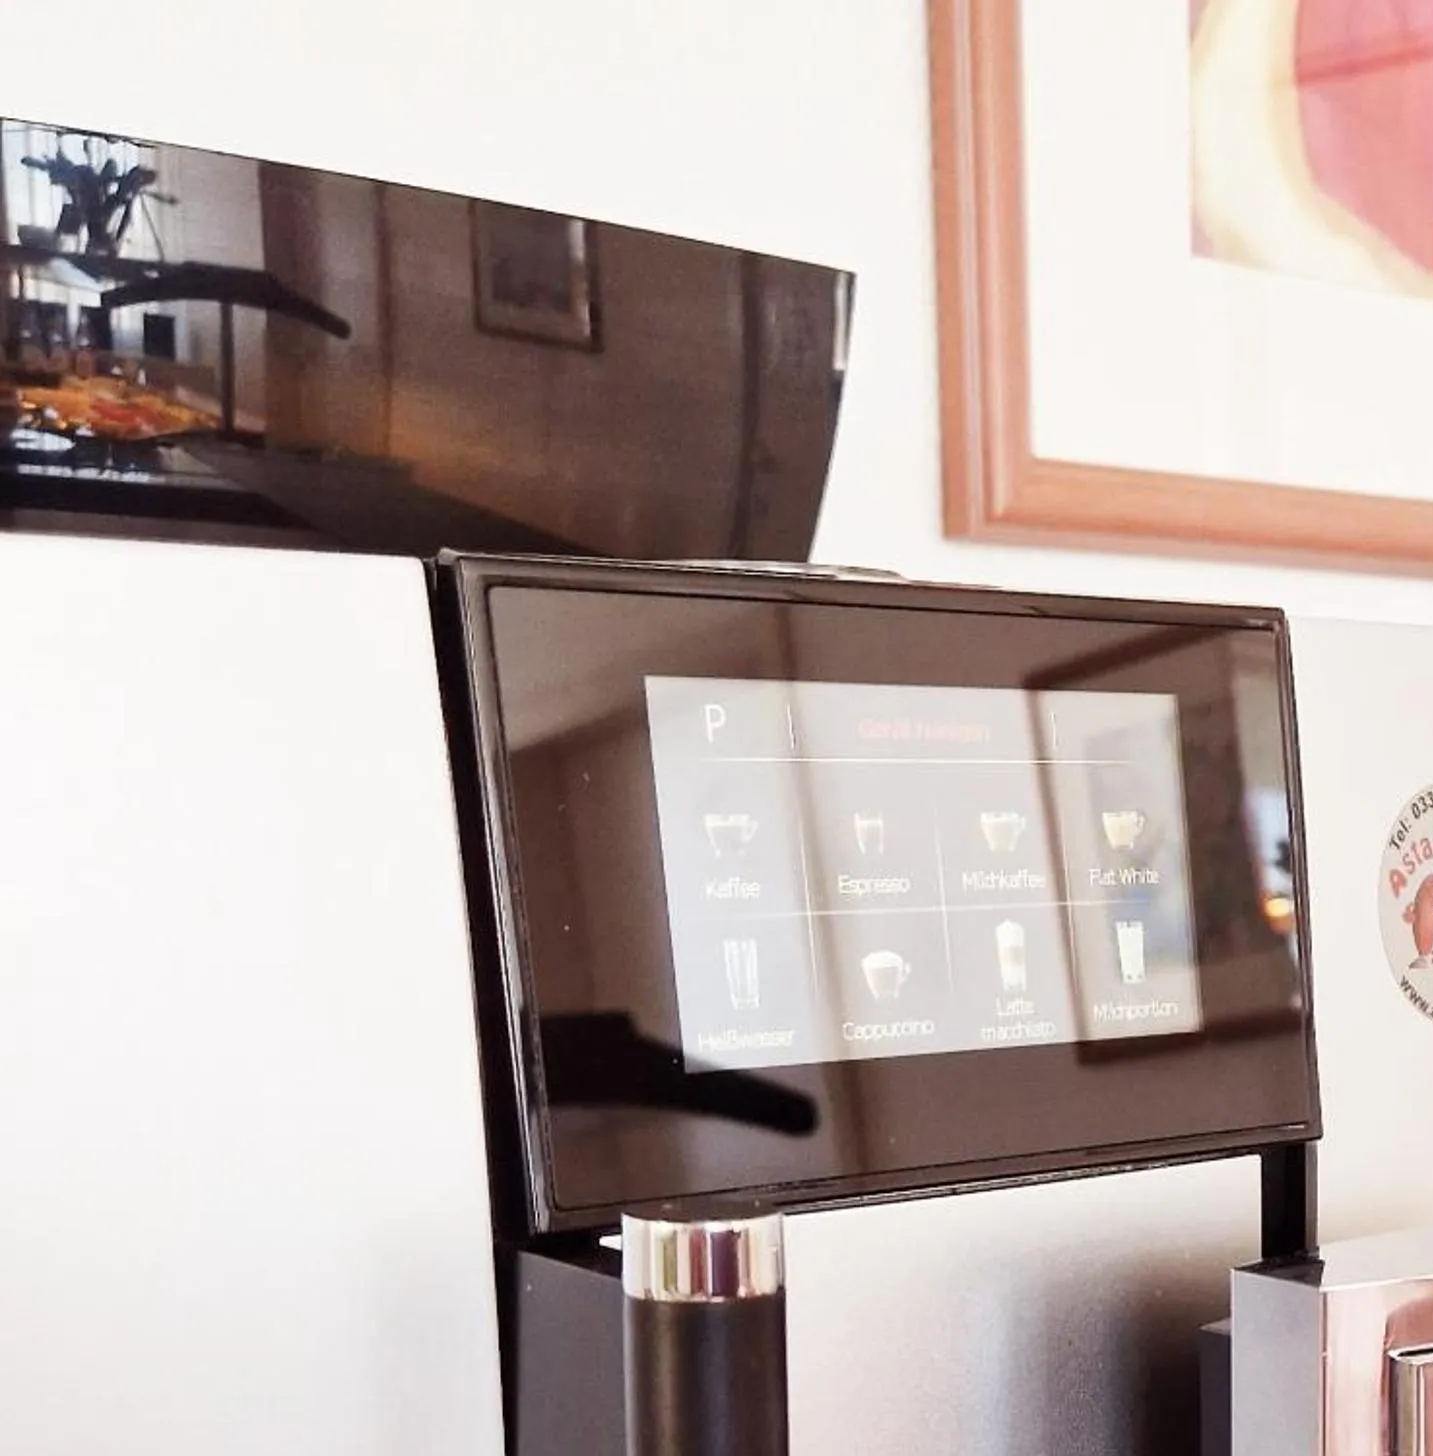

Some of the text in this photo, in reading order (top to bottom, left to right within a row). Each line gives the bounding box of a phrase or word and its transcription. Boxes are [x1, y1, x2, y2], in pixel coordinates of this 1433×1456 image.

[704, 703, 727, 742] P
[1388, 817, 1412, 851] Tel:
[1117, 867, 1161, 886] White
[1388, 836, 1433, 898] Asta
[705, 878, 761, 899] Kaffee
[838, 874, 911, 898] Espresso
[961, 870, 1047, 892] Milchkaffee
[996, 996, 1034, 1017] Latte
[842, 1017, 935, 1042] Cappuccino
[980, 1020, 1057, 1041] macchiato
